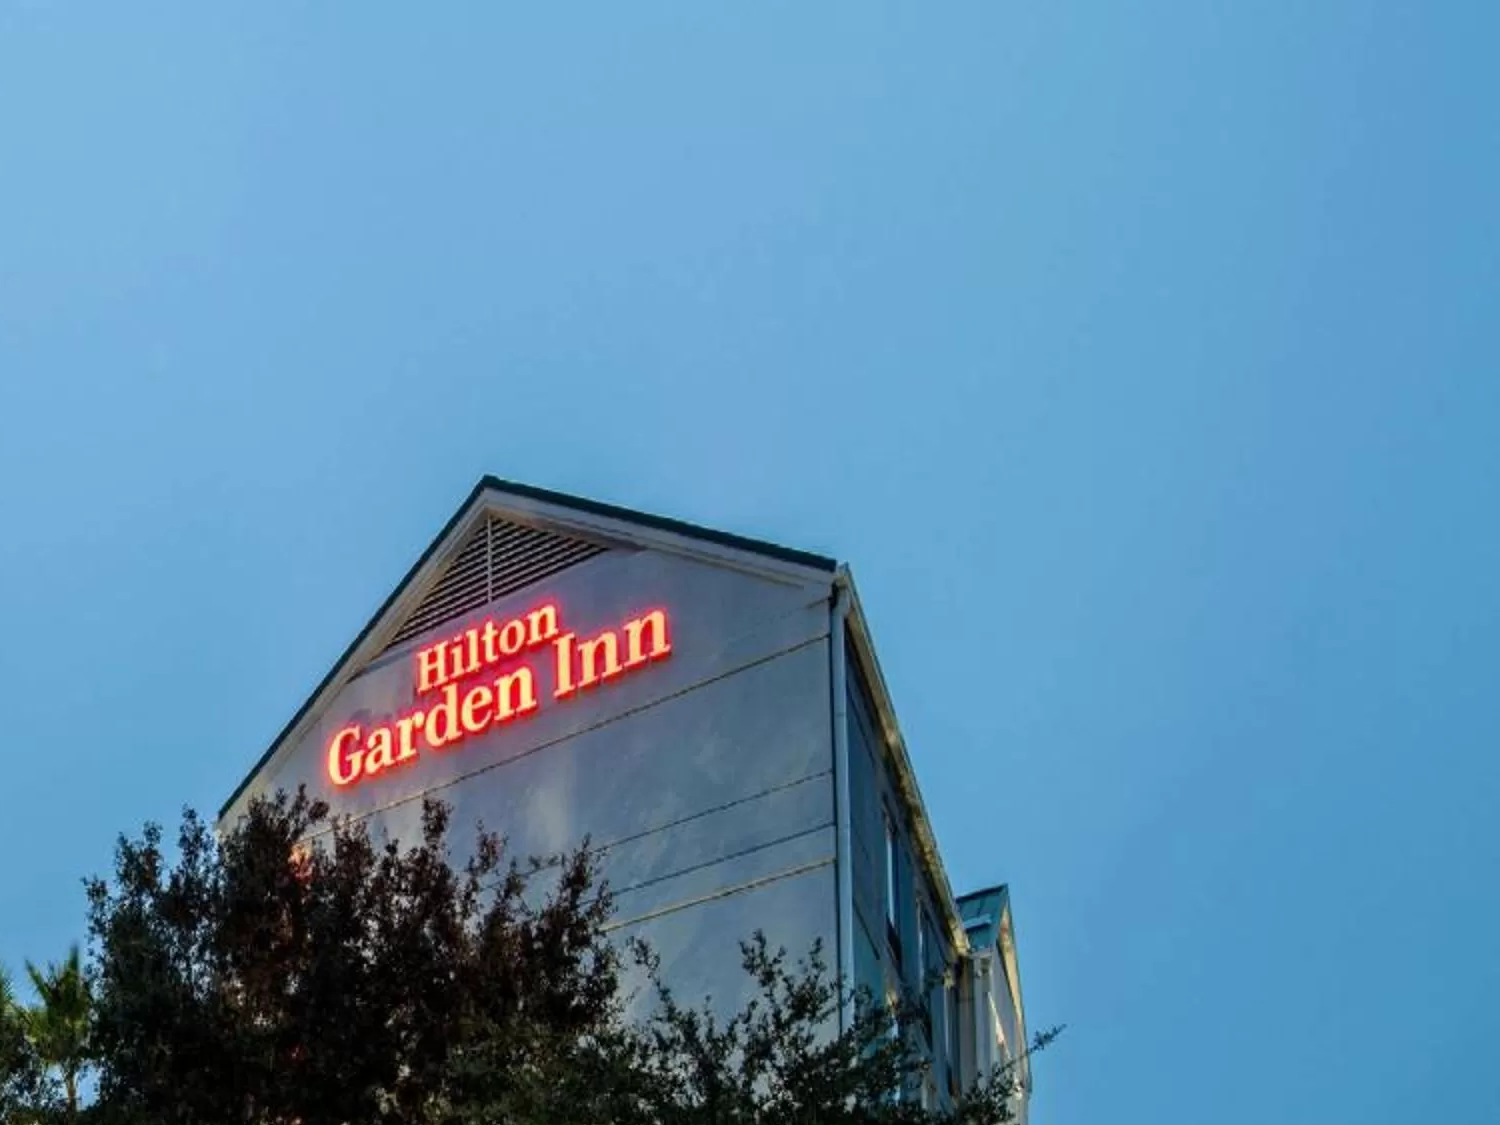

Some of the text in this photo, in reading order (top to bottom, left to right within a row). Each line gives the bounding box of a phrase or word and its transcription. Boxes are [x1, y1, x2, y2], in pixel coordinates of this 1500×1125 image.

[325, 606, 672, 787] Garden Inn
[415, 603, 561, 694] Hilton
